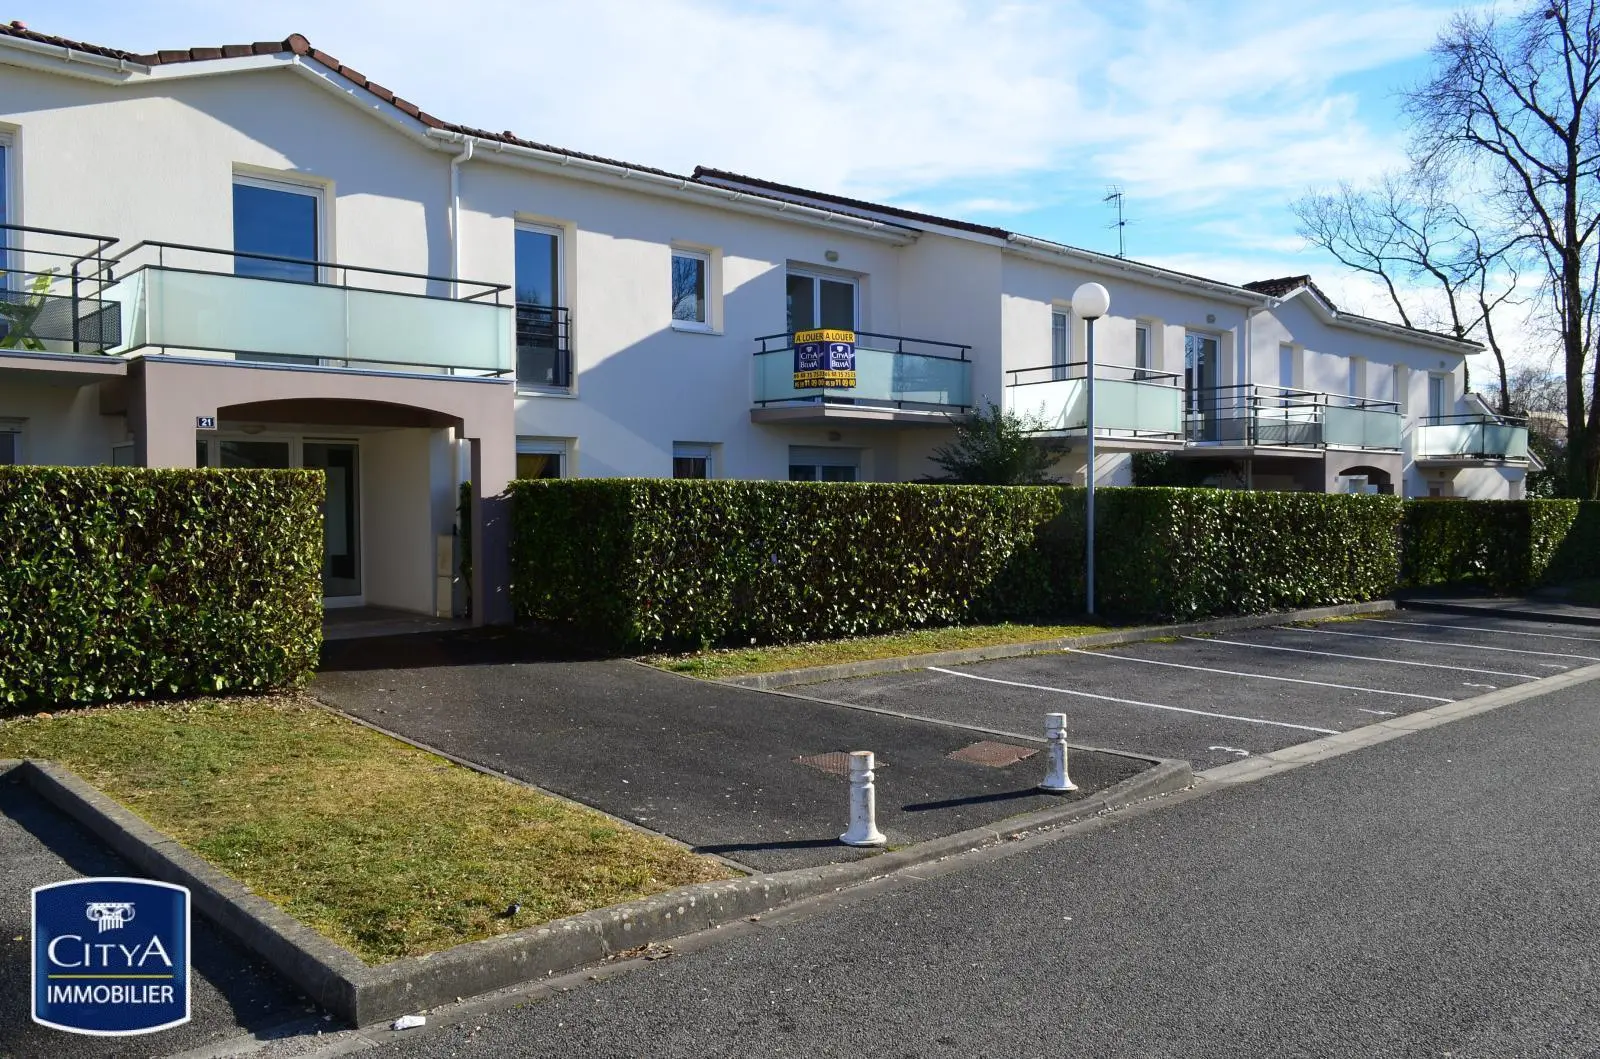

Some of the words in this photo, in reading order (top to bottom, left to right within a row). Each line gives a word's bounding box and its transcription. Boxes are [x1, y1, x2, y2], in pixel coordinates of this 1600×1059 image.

[796, 334, 801, 342] A
[802, 332, 824, 341] LOUER
[831, 333, 854, 341] LOUER
[201, 418, 211, 426] 21
